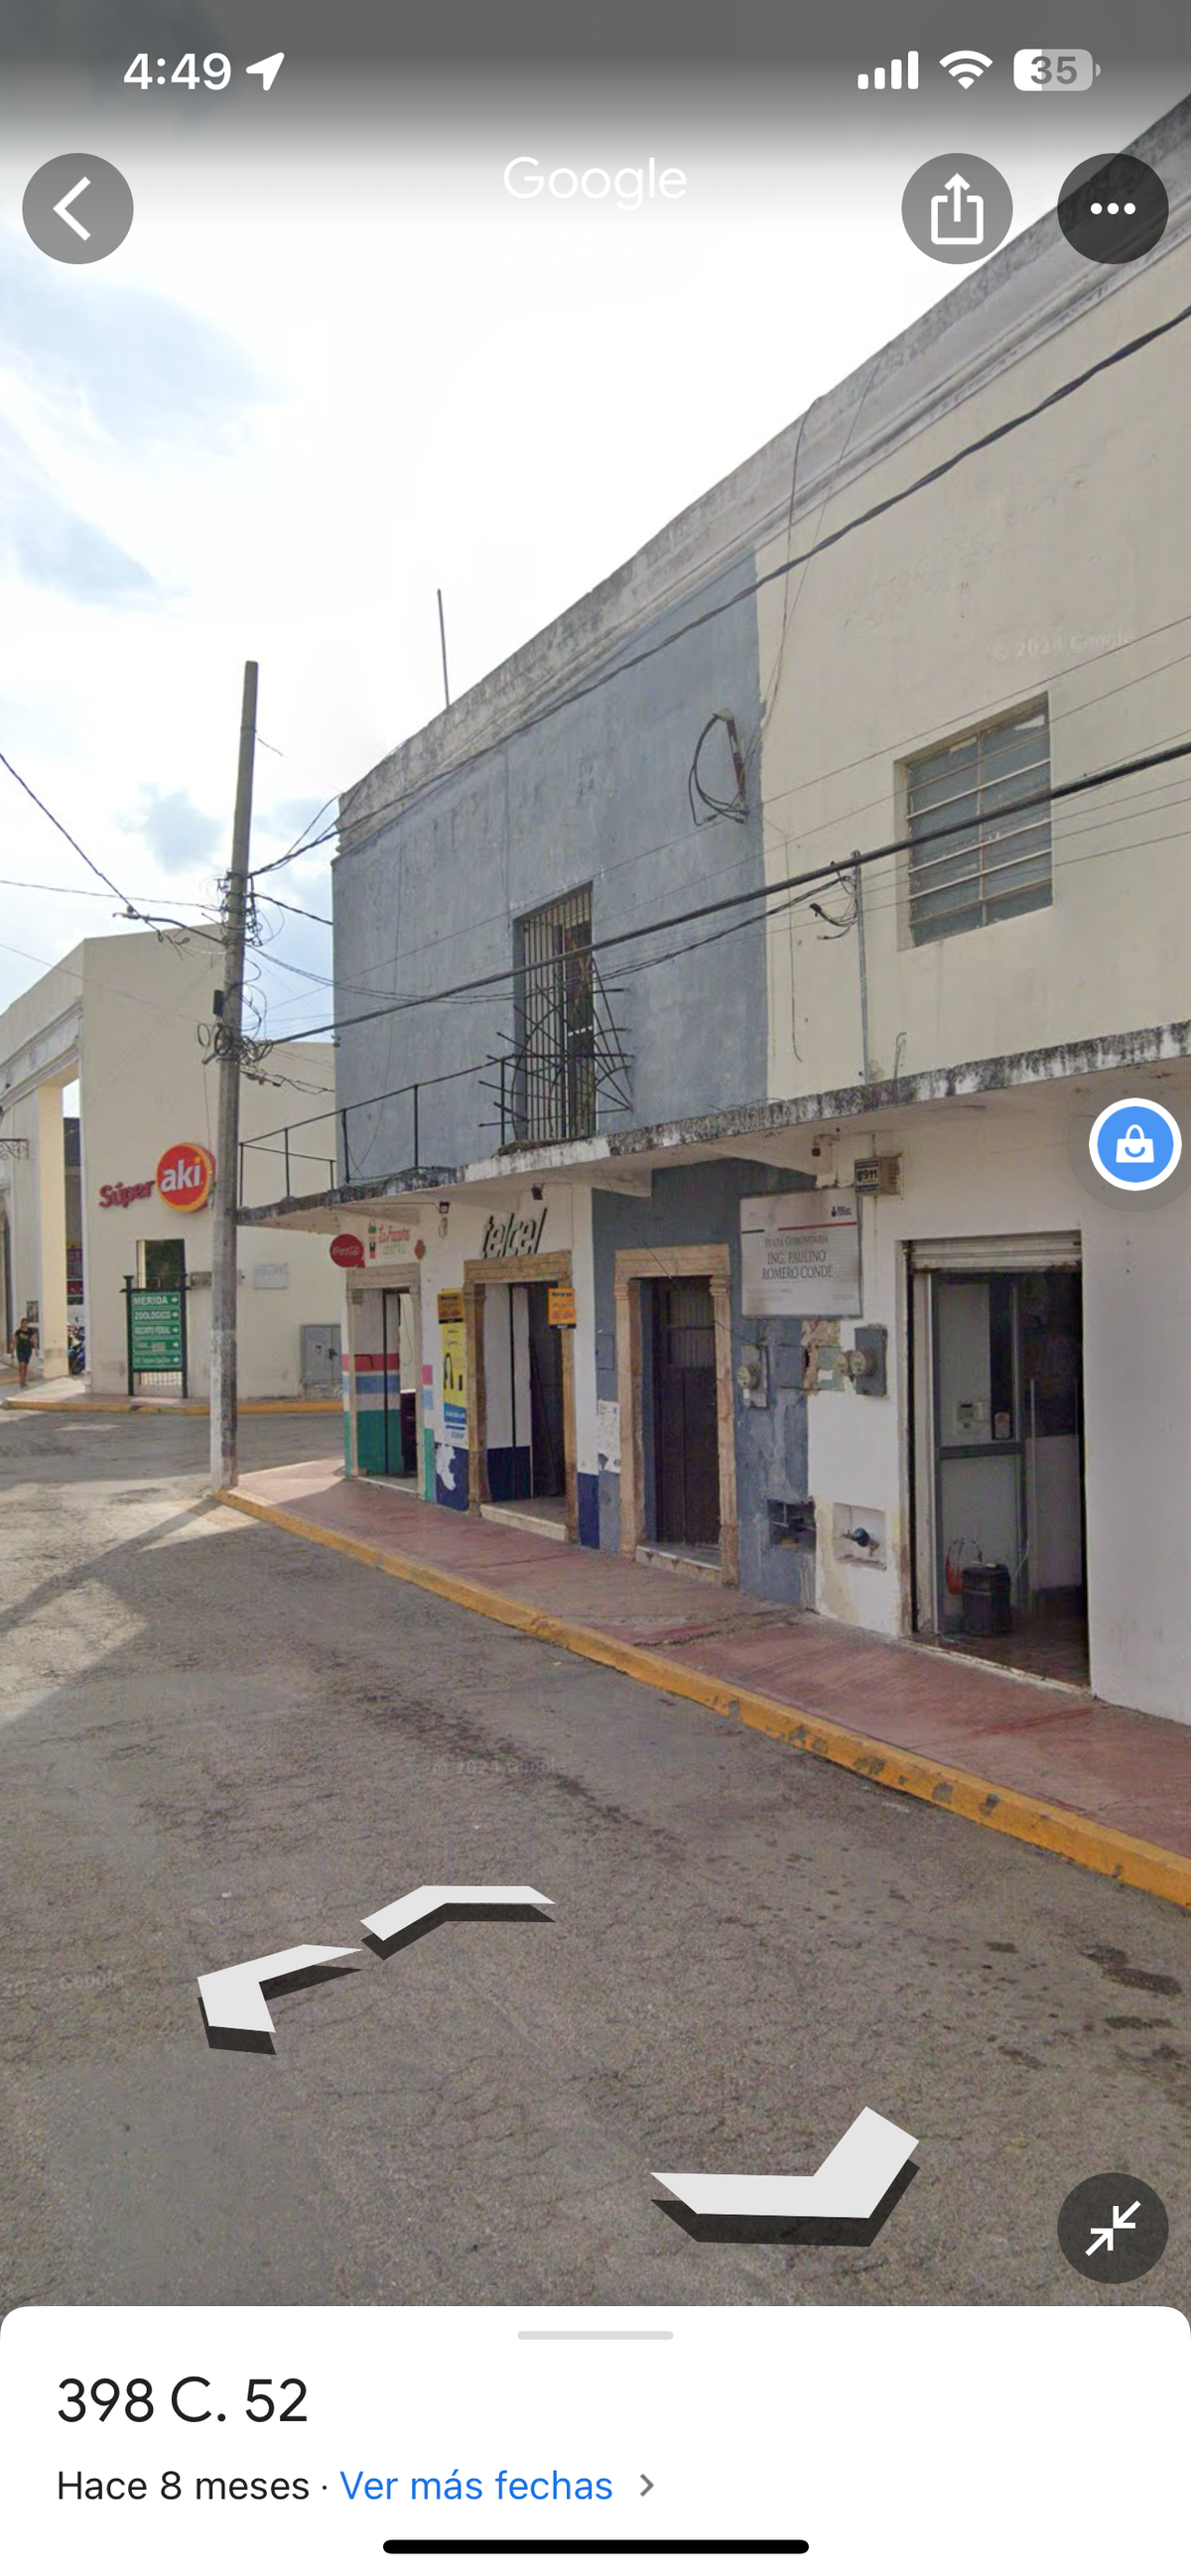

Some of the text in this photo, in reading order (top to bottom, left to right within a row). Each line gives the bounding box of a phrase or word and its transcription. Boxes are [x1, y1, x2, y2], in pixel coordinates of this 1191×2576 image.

[98, 1155, 201, 1209] Súper aki
[481, 1208, 548, 1259] telcel
[762, 1264, 834, 1280] ROMERO CONDE
[788, 1249, 826, 1263] PAULINO
